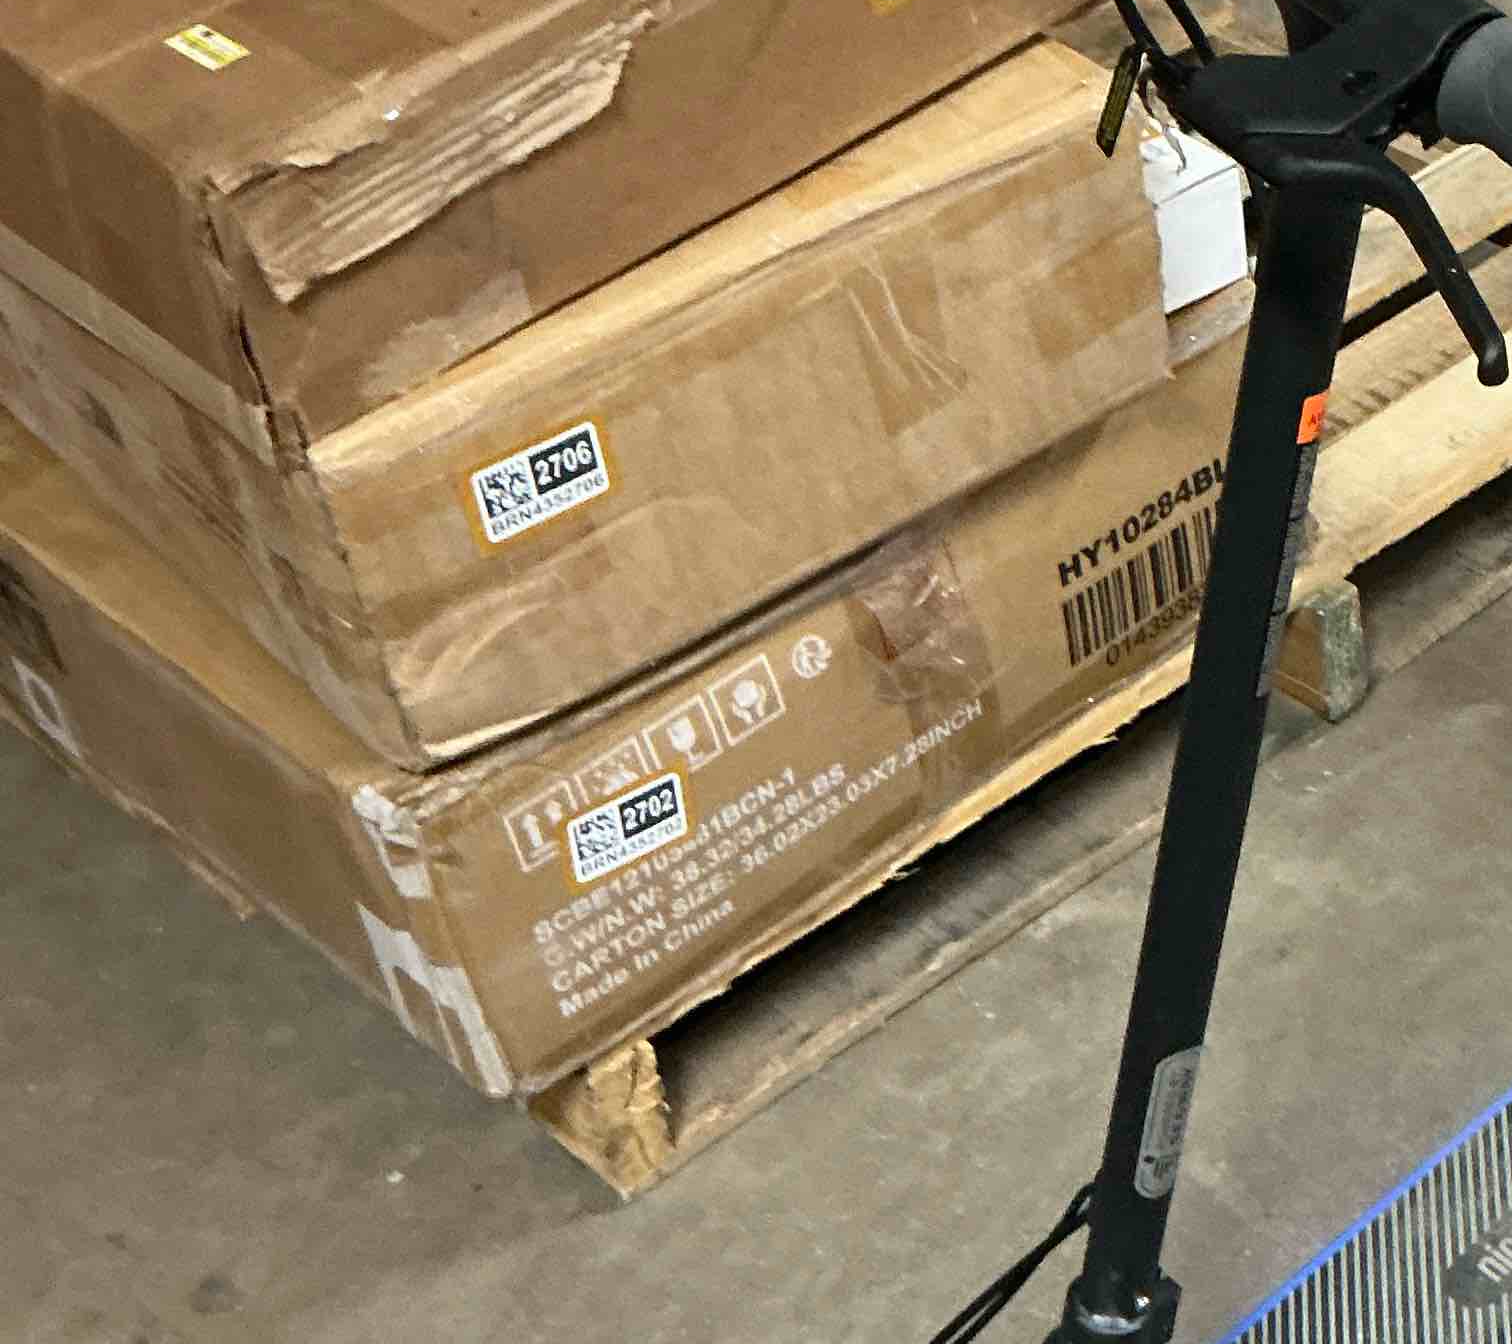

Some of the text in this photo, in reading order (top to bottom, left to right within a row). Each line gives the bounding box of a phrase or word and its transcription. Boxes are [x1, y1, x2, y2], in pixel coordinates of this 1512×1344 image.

[534, 440, 593, 486] 2706
[622, 788, 674, 831] 2702
[663, 898, 737, 952] China
[551, 911, 667, 993] CARTON
